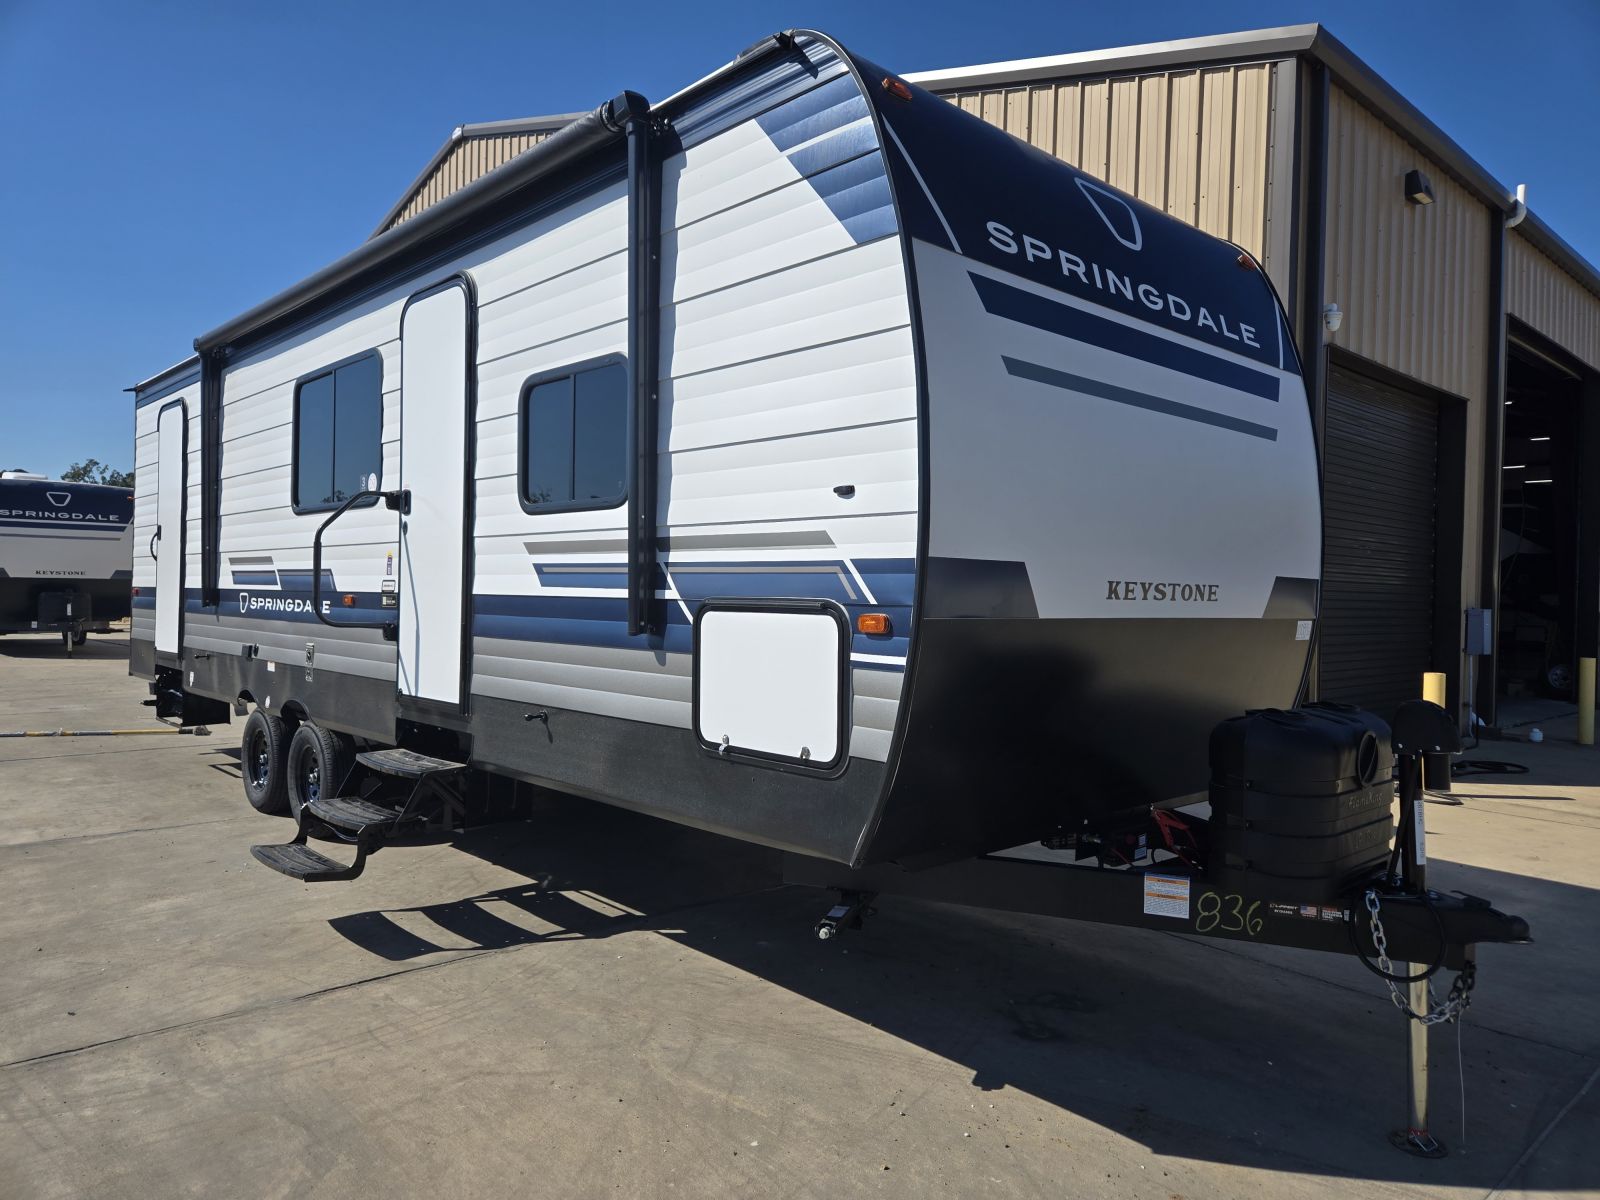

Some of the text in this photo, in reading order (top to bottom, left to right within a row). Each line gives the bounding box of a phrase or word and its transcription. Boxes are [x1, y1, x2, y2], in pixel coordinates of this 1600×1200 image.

[985, 221, 1260, 349] SPRINGDALE
[0, 509, 120, 521] SPRINGDALE
[1105, 580, 1220, 602] KEYSTONE
[249, 597, 331, 614] SPRINGDAE
[1195, 891, 1264, 936] 836
